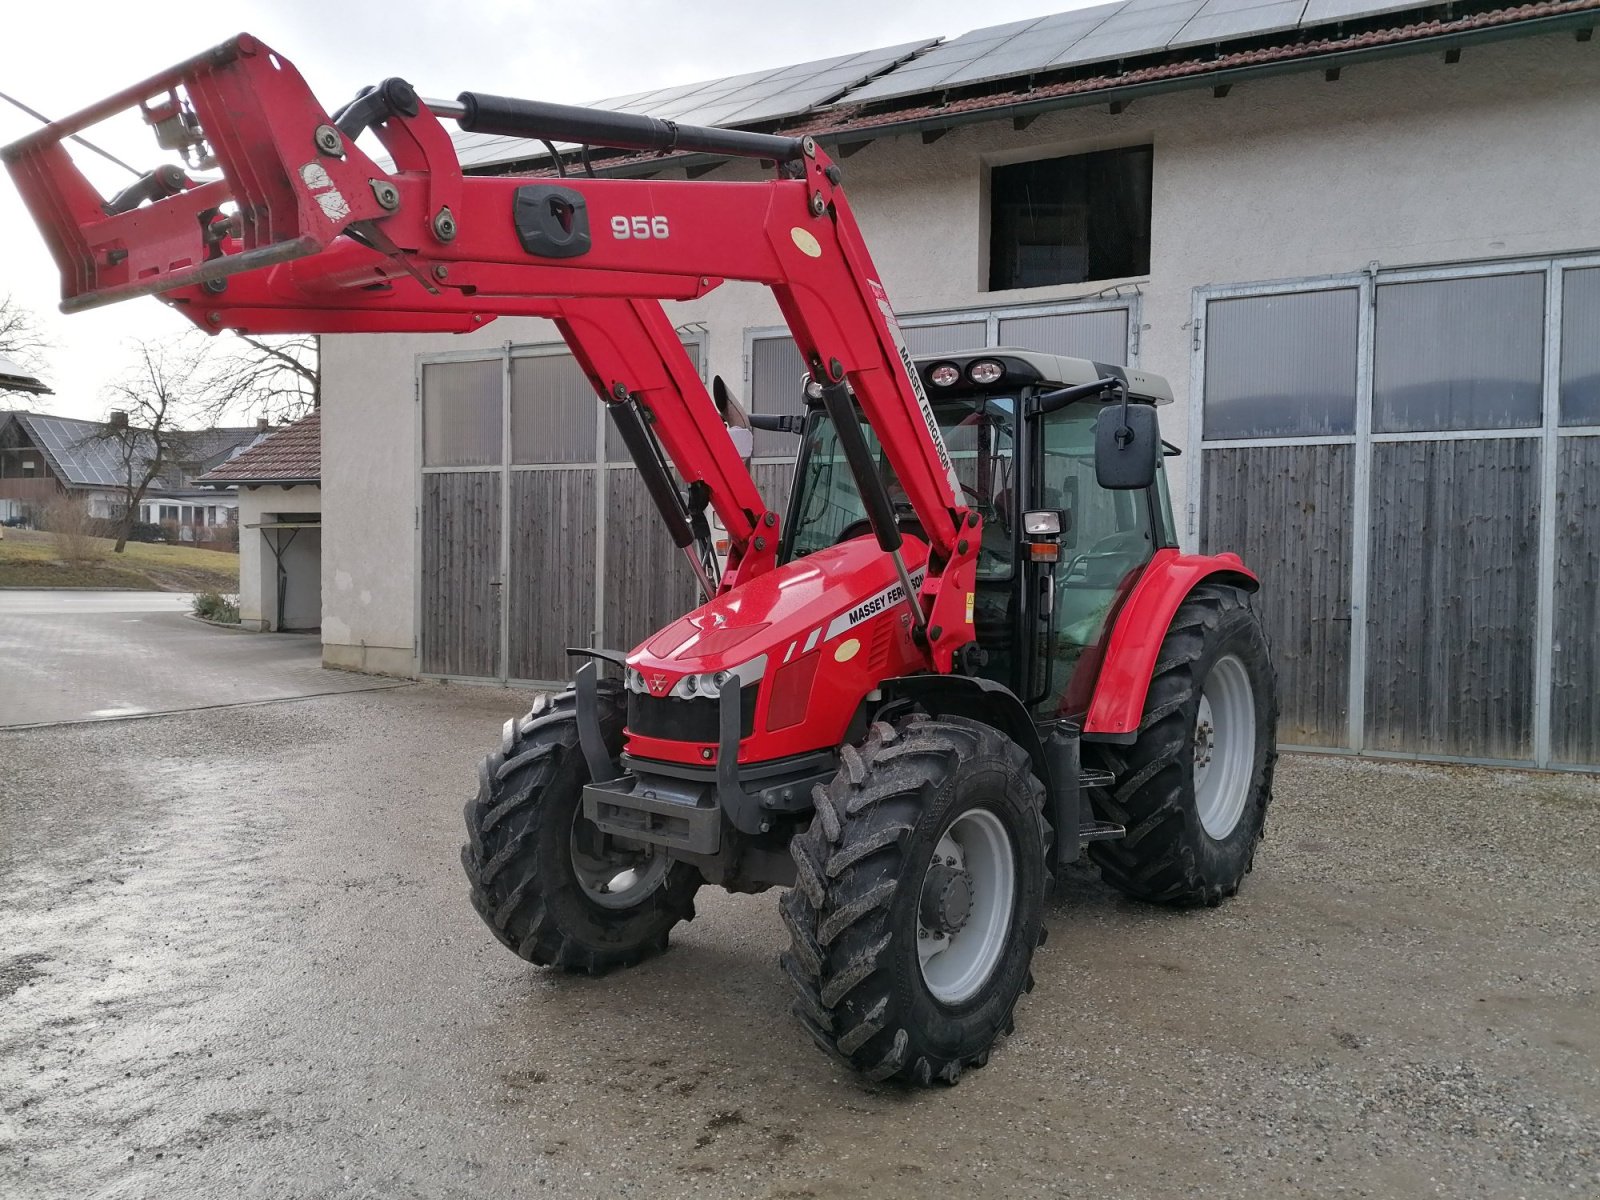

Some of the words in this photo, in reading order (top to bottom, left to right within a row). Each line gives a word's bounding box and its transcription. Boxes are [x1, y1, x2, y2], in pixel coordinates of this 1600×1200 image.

[611, 215, 669, 239] 956
[900, 346, 924, 403] MASSEY
[922, 404, 950, 470] FERGUSON
[849, 595, 886, 625] MASSEY
